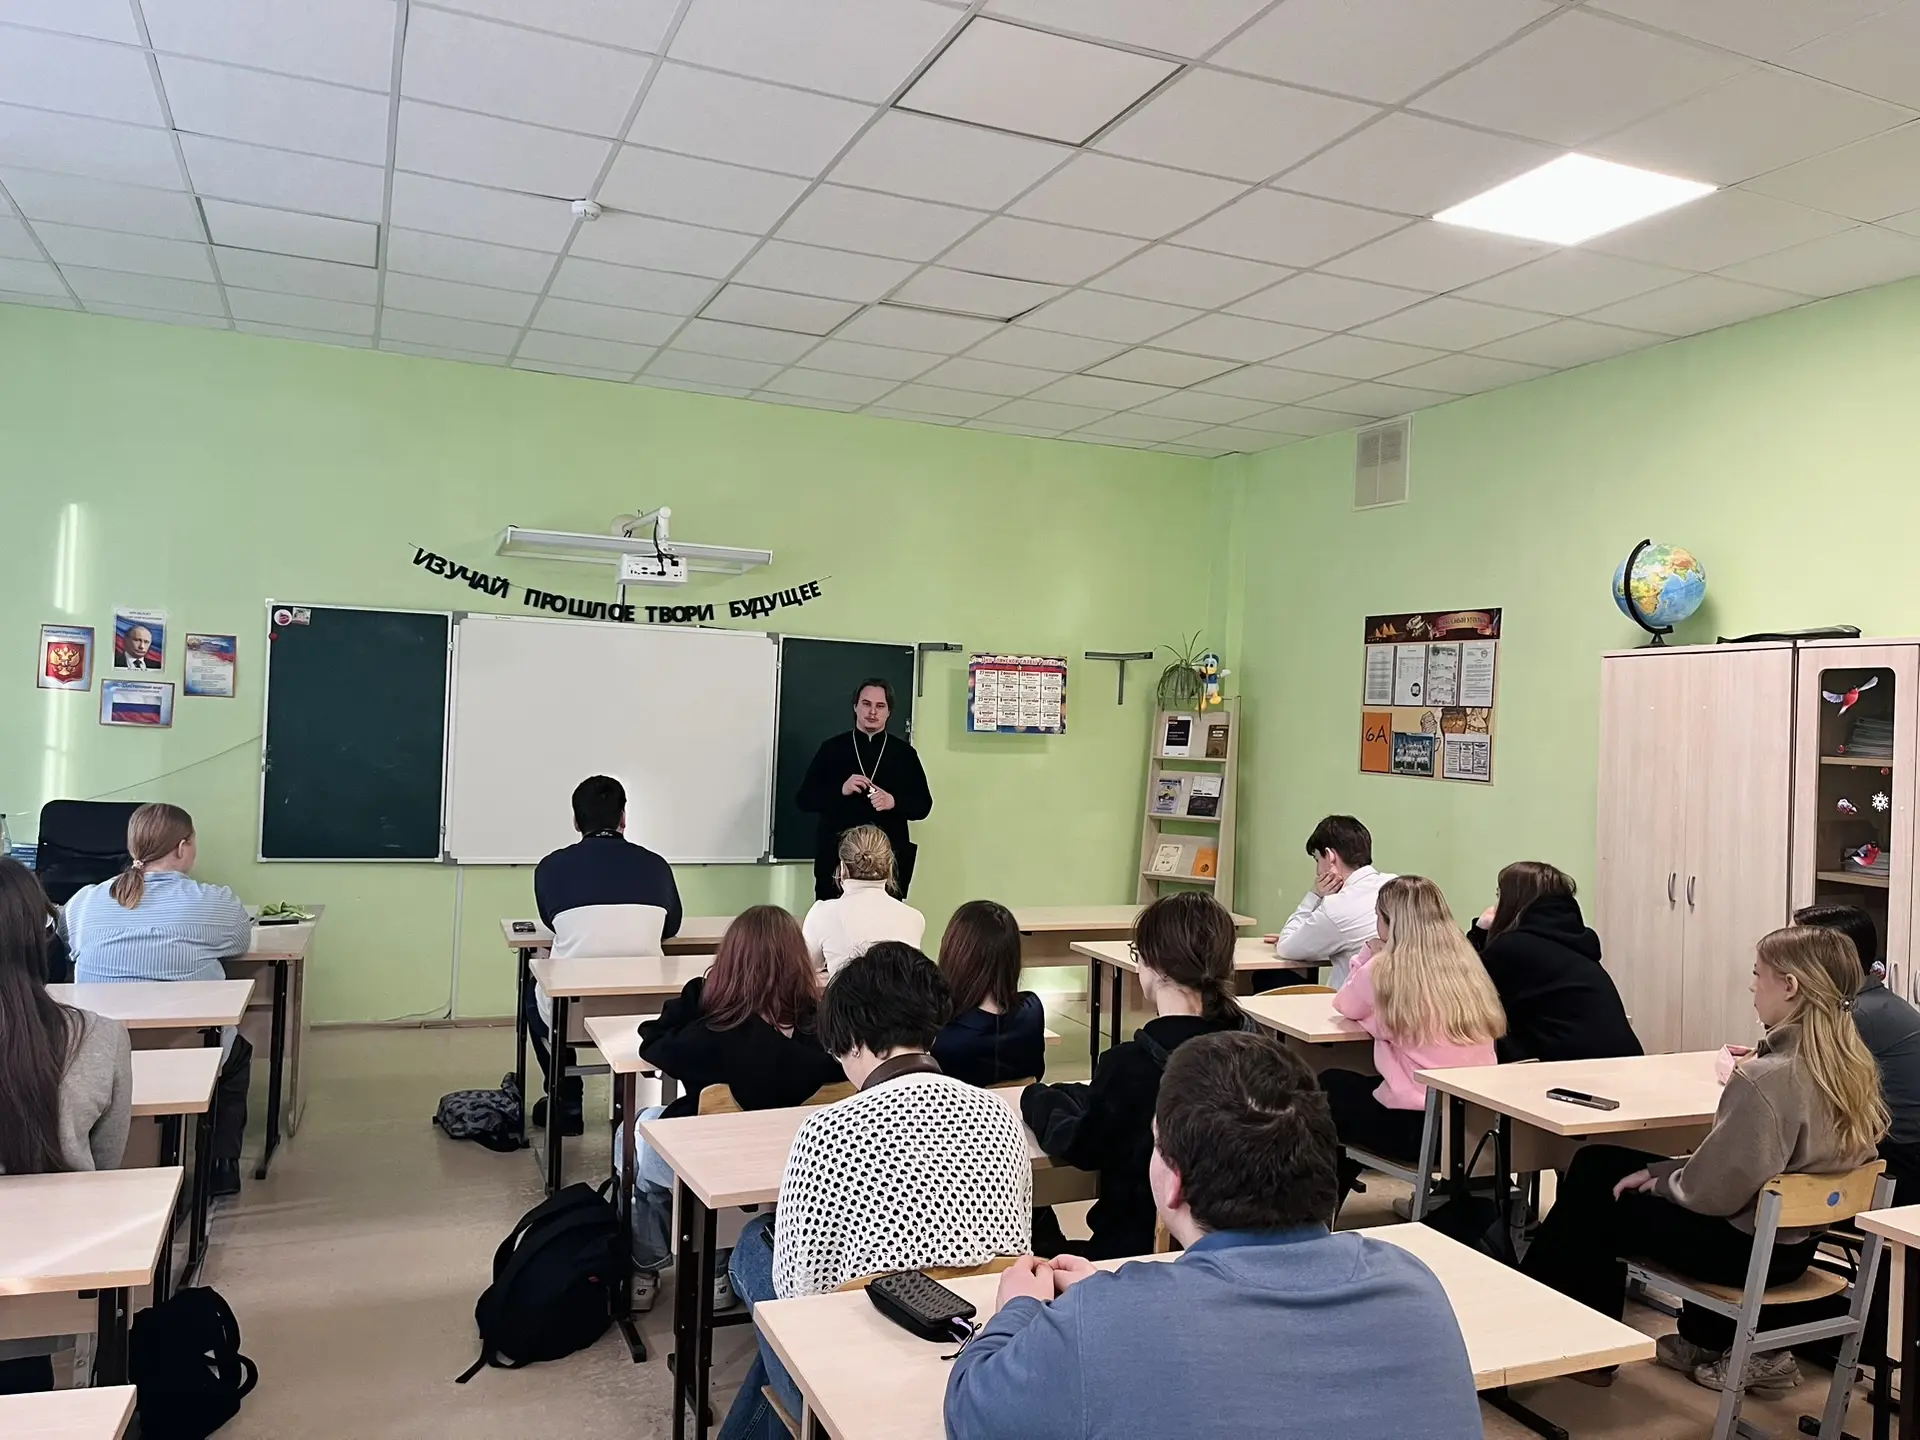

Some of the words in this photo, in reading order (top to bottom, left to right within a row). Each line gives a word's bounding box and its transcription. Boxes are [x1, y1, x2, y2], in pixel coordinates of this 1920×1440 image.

[412, 547, 510, 599] ИЗУЧАЙ
[523, 588, 635, 622] ПРОШЛОЕ
[645, 604, 714, 622] ТВОРИ
[728, 580, 822, 619] БУДУЩЕЕ
